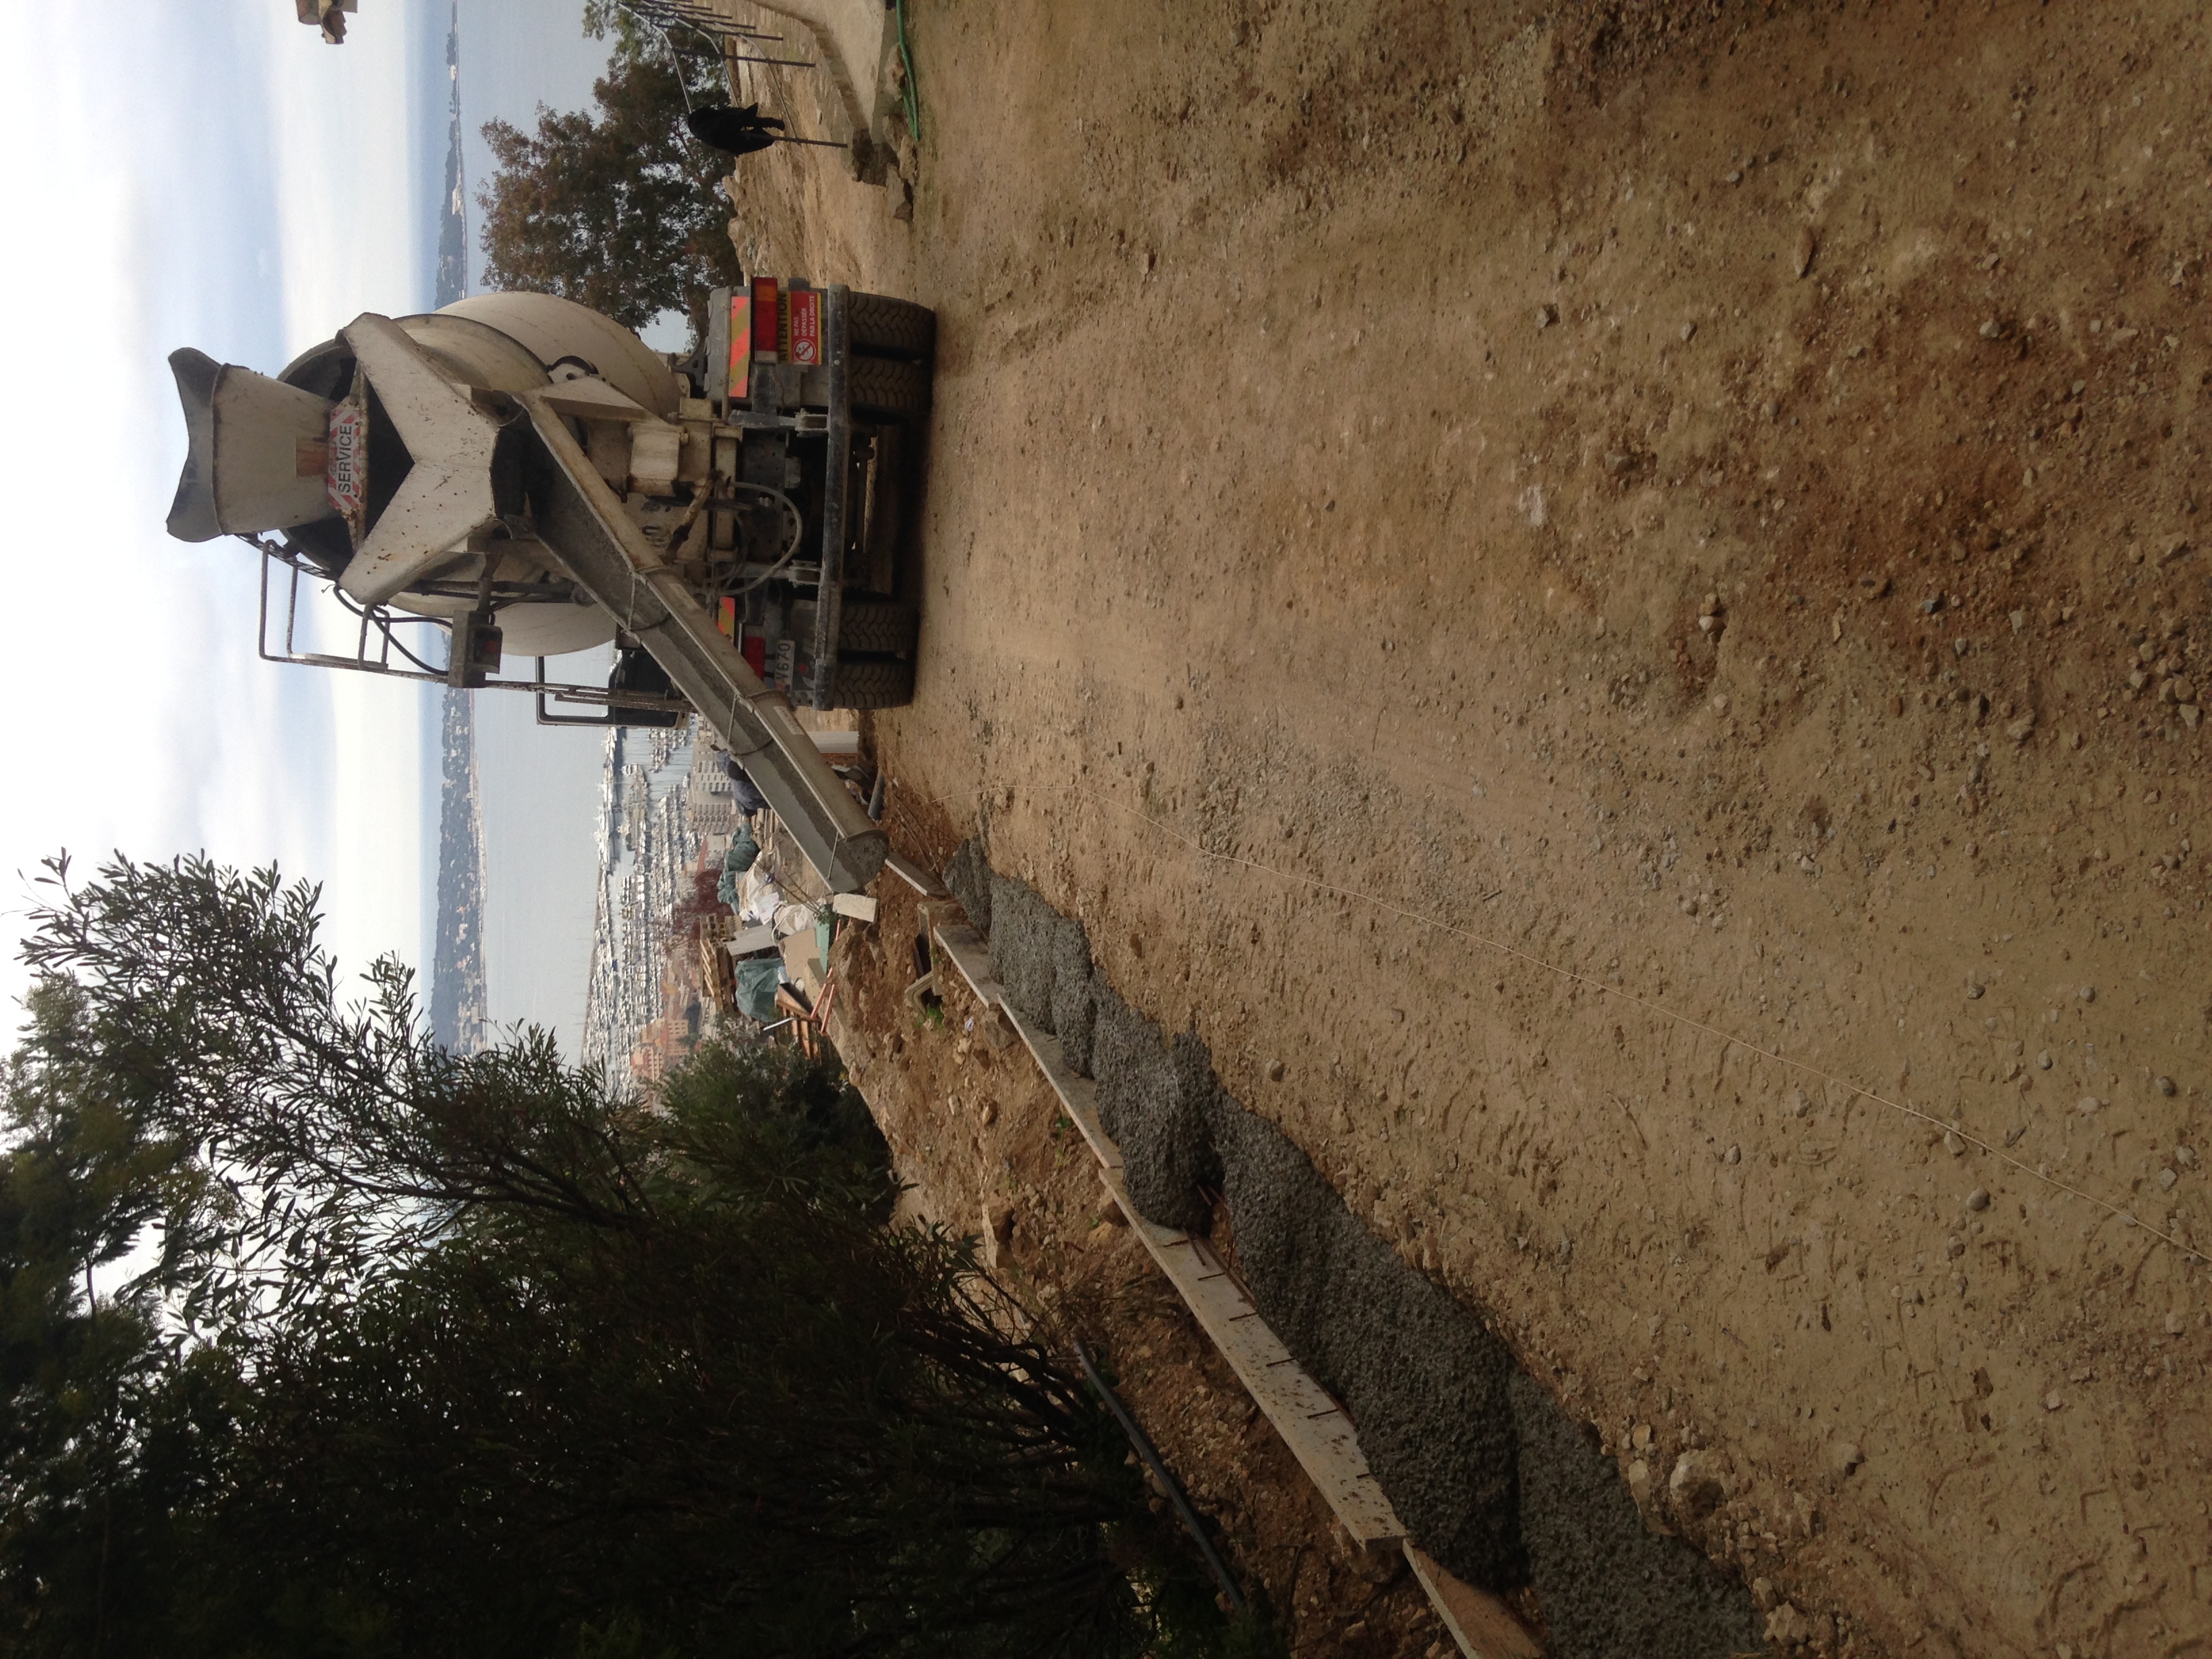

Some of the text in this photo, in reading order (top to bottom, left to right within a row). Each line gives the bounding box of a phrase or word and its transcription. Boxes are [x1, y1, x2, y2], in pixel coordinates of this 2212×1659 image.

[777, 293, 788, 361] ATTENTION
[794, 328, 800, 336] NE
[809, 316, 815, 325] LA
[337, 425, 352, 493] SERVICE
[776, 643, 791, 680] V670
